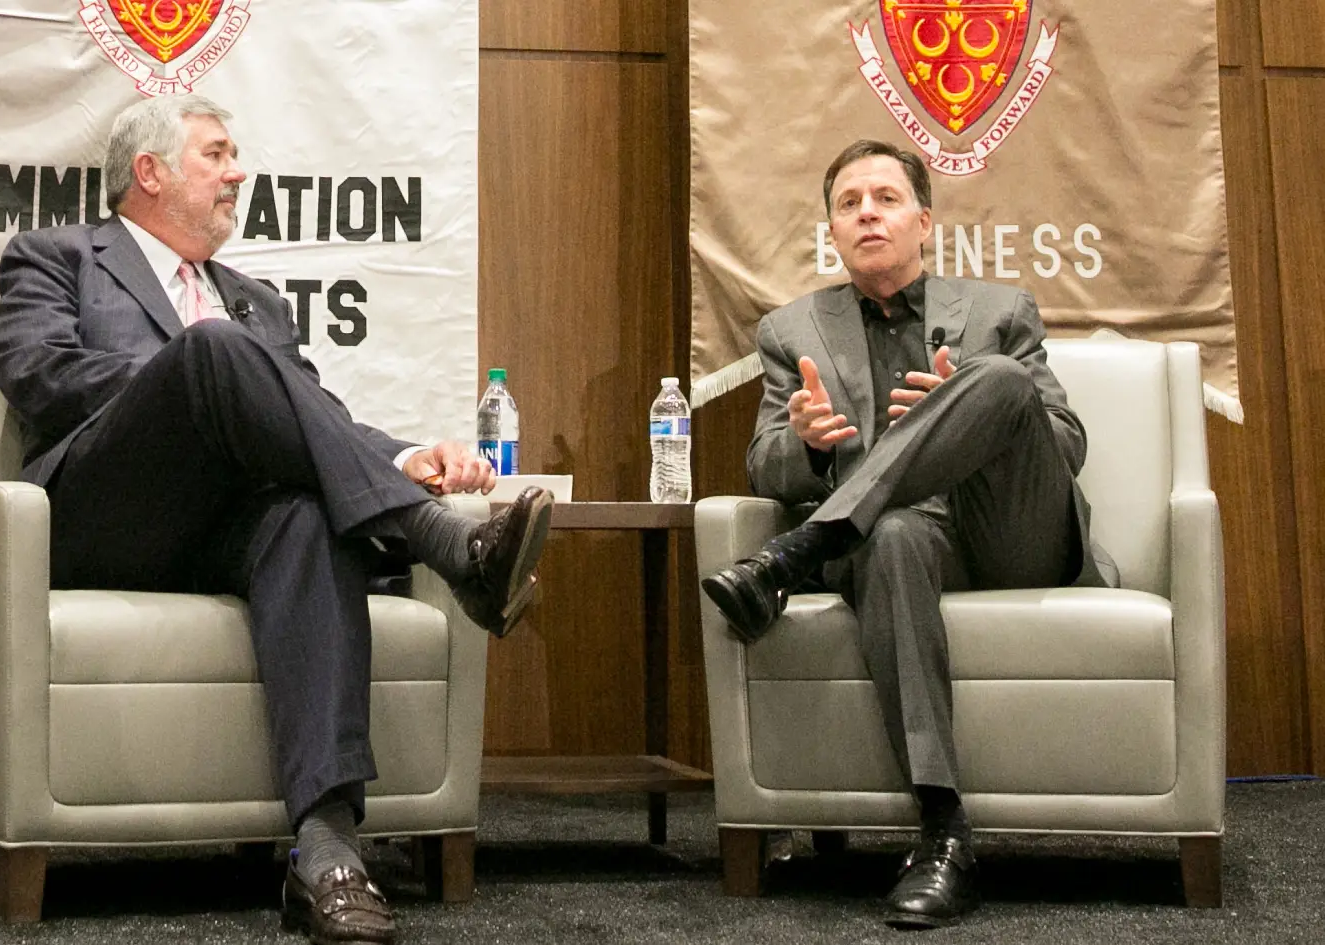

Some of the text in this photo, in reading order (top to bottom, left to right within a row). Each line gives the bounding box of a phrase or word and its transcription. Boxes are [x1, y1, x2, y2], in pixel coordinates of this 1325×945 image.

[88, 15, 244, 94] HAZARD ZET FORWARD
[870, 69, 1045, 172] HAZARD ZET FORWARD
[816, 222, 1104, 279] BINESS
